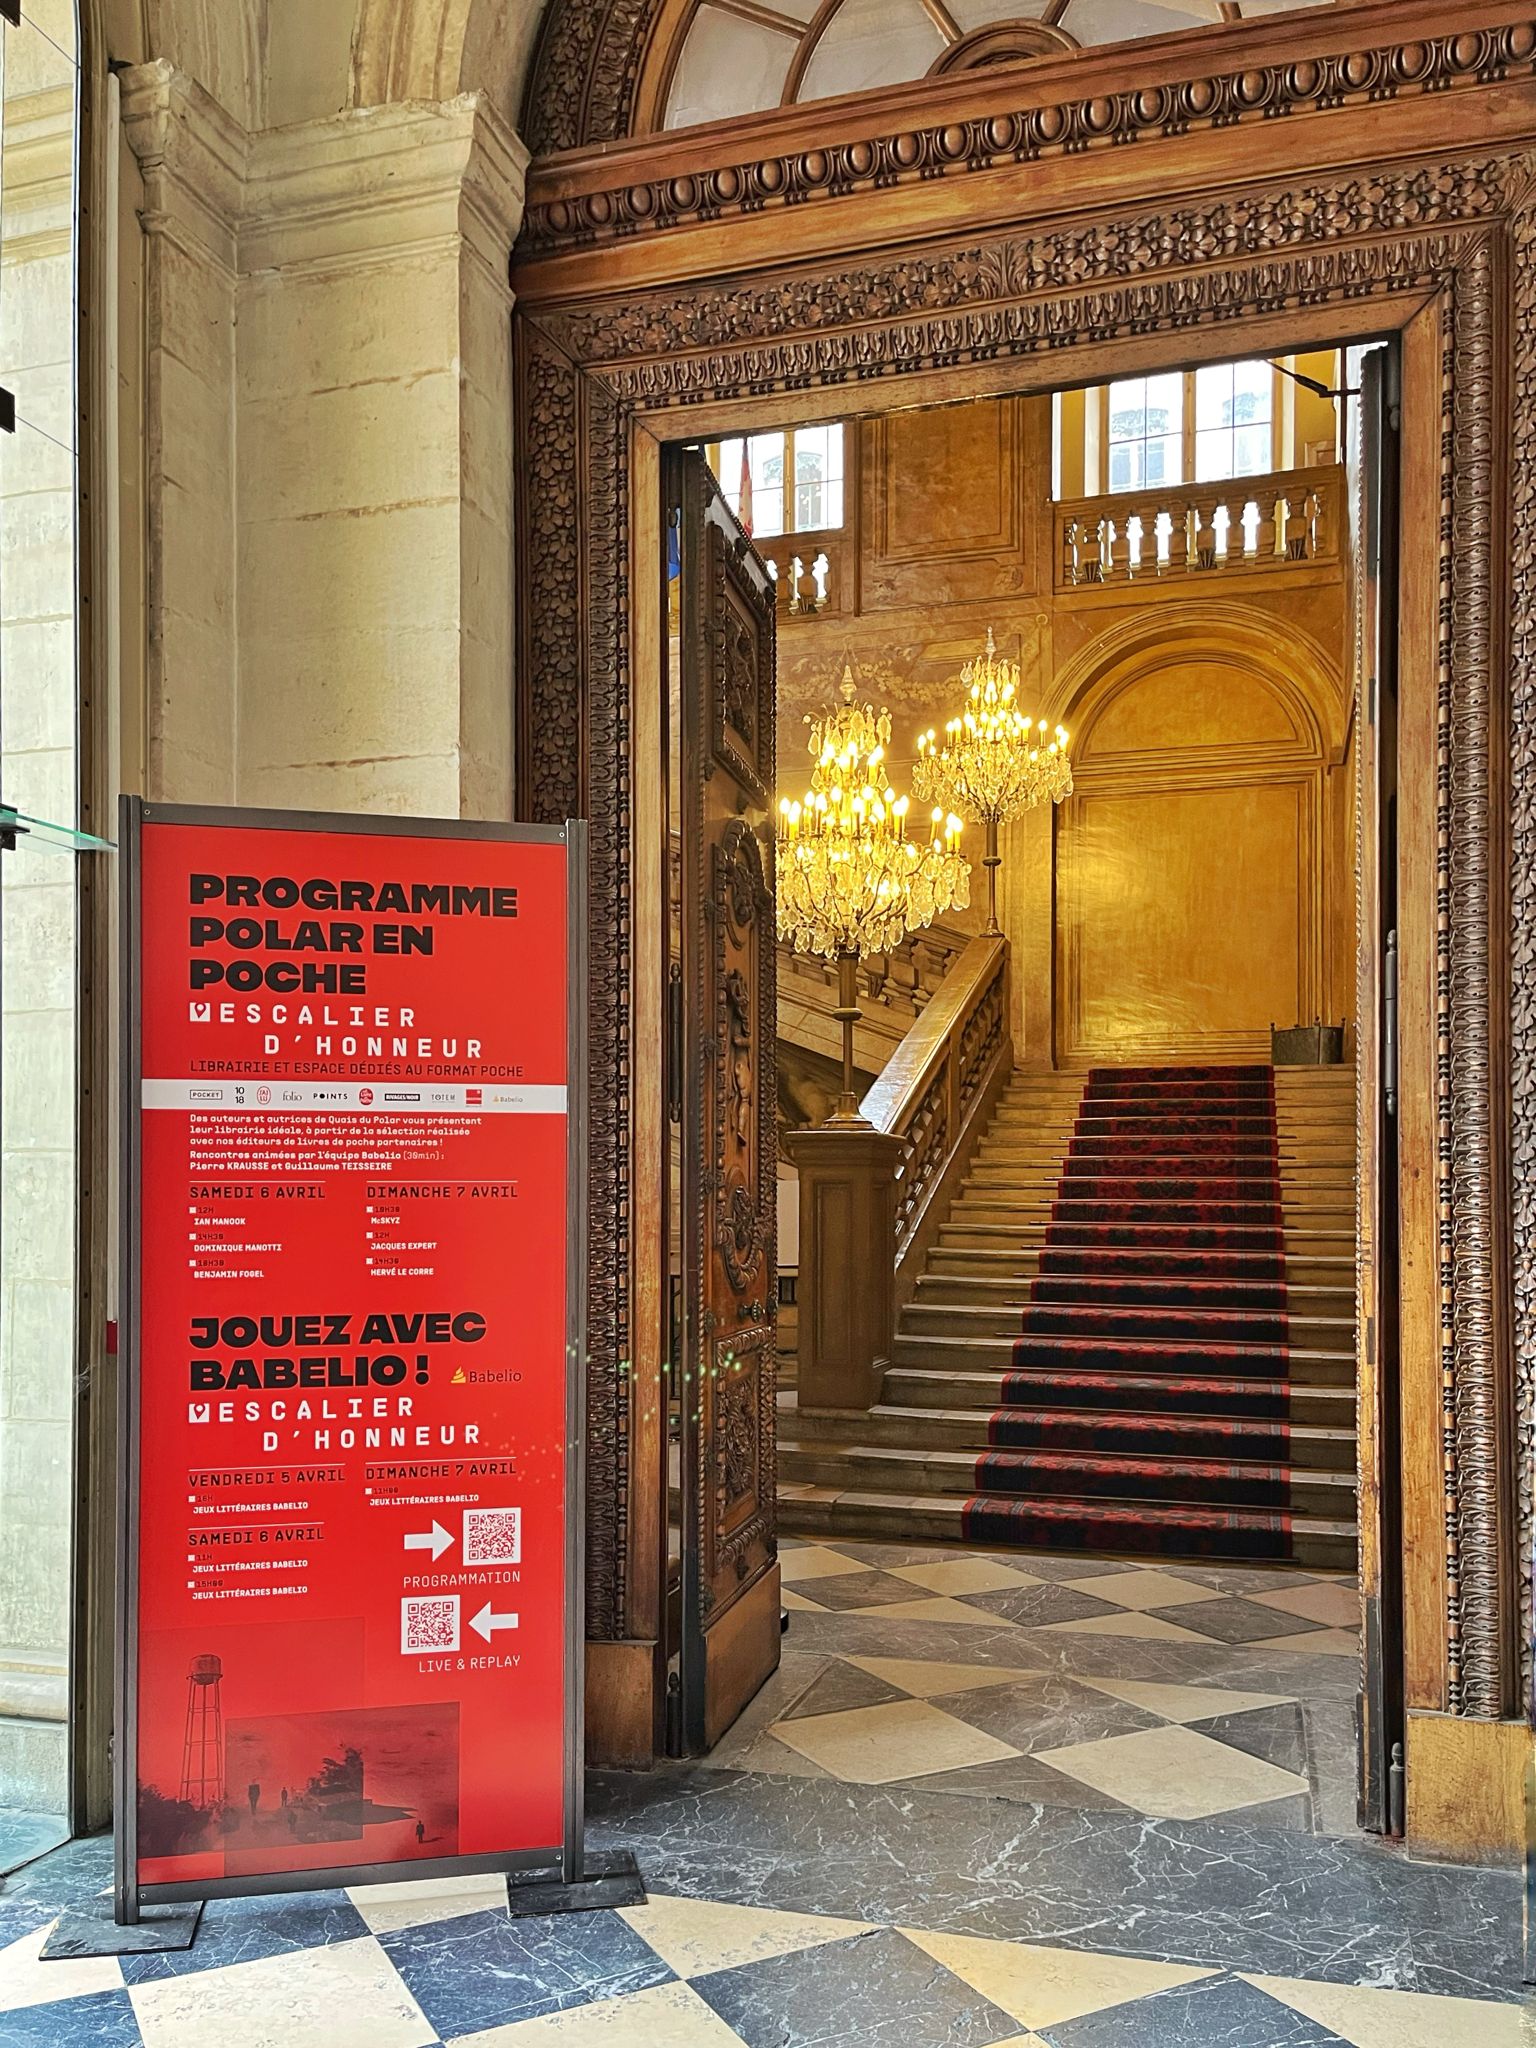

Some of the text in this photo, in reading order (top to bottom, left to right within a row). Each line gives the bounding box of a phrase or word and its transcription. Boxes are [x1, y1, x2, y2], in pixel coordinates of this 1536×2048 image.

[190, 873, 518, 917] PROGRAMME
[190, 916, 434, 956] POLAR EN
[190, 959, 366, 994] POCHE
[219, 1002, 415, 1027] ESCALIER
[264, 1034, 482, 1058] D'HONNEUR
[190, 1060, 523, 1077] LIBRAIRIE ET ESPACE DÉDIÉS AU FORMAT POCHE
[235, 1087, 245, 1095] 10
[283, 1091, 302, 1101] folio
[236, 1096, 245, 1104] 18
[190, 1114, 208, 1122] Des
[211, 1115, 250, 1123] auteurs
[254, 1115, 265, 1123] et
[267, 1115, 312, 1123] autrices
[314, 1115, 326, 1123] de
[329, 1116, 357, 1124] Quais
[360, 1116, 370, 1124] du
[374, 1116, 400, 1124] Polar
[427, 1117, 481, 1126] présentent
[190, 1126, 212, 1134] leur
[215, 1126, 265, 1134] librairie
[306, 1126, 312, 1134] à
[314, 1126, 347, 1135] partir
[350, 1127, 360, 1135] de
[364, 1127, 374, 1135] la
[377, 1127, 425, 1135] sélection
[427, 1127, 470, 1135] réalisée
[236, 1137, 281, 1146] éditeurs
[284, 1138, 295, 1146] de
[298, 1138, 329, 1146] livres
[332, 1138, 343, 1146] de
[346, 1139, 374, 1147] poche
[377, 1139, 437, 1147] partenaires
[252, 1151, 296, 1159] animées
[318, 1151, 359, 1161] l'équipe
[190, 1162, 224, 1170] Pierre
[227, 1162, 269, 1170] KRAUSSE
[285, 1162, 339, 1170] Guillaume
[342, 1162, 392, 1170] TEISSEIRE
[190, 1186, 325, 1198] SAMEDI 6 AVRIL
[367, 1186, 518, 1198] DIMANCHE 7 AVRIL
[194, 1244, 243, 1252] DOMINIQUE
[240, 1270, 264, 1278] FOGEL
[371, 1267, 396, 1275] HERVÉ
[189, 1311, 487, 1350] JOUEZ AVEC
[190, 1355, 407, 1391] BABELIO
[469, 1370, 522, 1384] Babelio
[218, 1397, 413, 1422] ESCALIER
[264, 1424, 480, 1451] D'HONNEUR
[366, 1463, 516, 1479] DIMANCHE 7 AVRIL
[190, 1470, 345, 1487] VENDREDI 5 AVRIL
[370, 1498, 389, 1506] JEUX
[392, 1495, 444, 1504] LITTÉRAIRES
[193, 1502, 308, 1514] JEUX LITTÉRAIRES BABELIO
[188, 1528, 324, 1546] SAMEDI 6 AVRIL
[192, 1560, 308, 1573] JEUX LITTÉRAIRES BABELIO
[403, 1572, 520, 1588] PROGRAMMATION
[192, 1586, 308, 1600] JEUX LITTÉRAIRES BABELIO
[420, 1656, 520, 1672] LIVE & REPLAY
